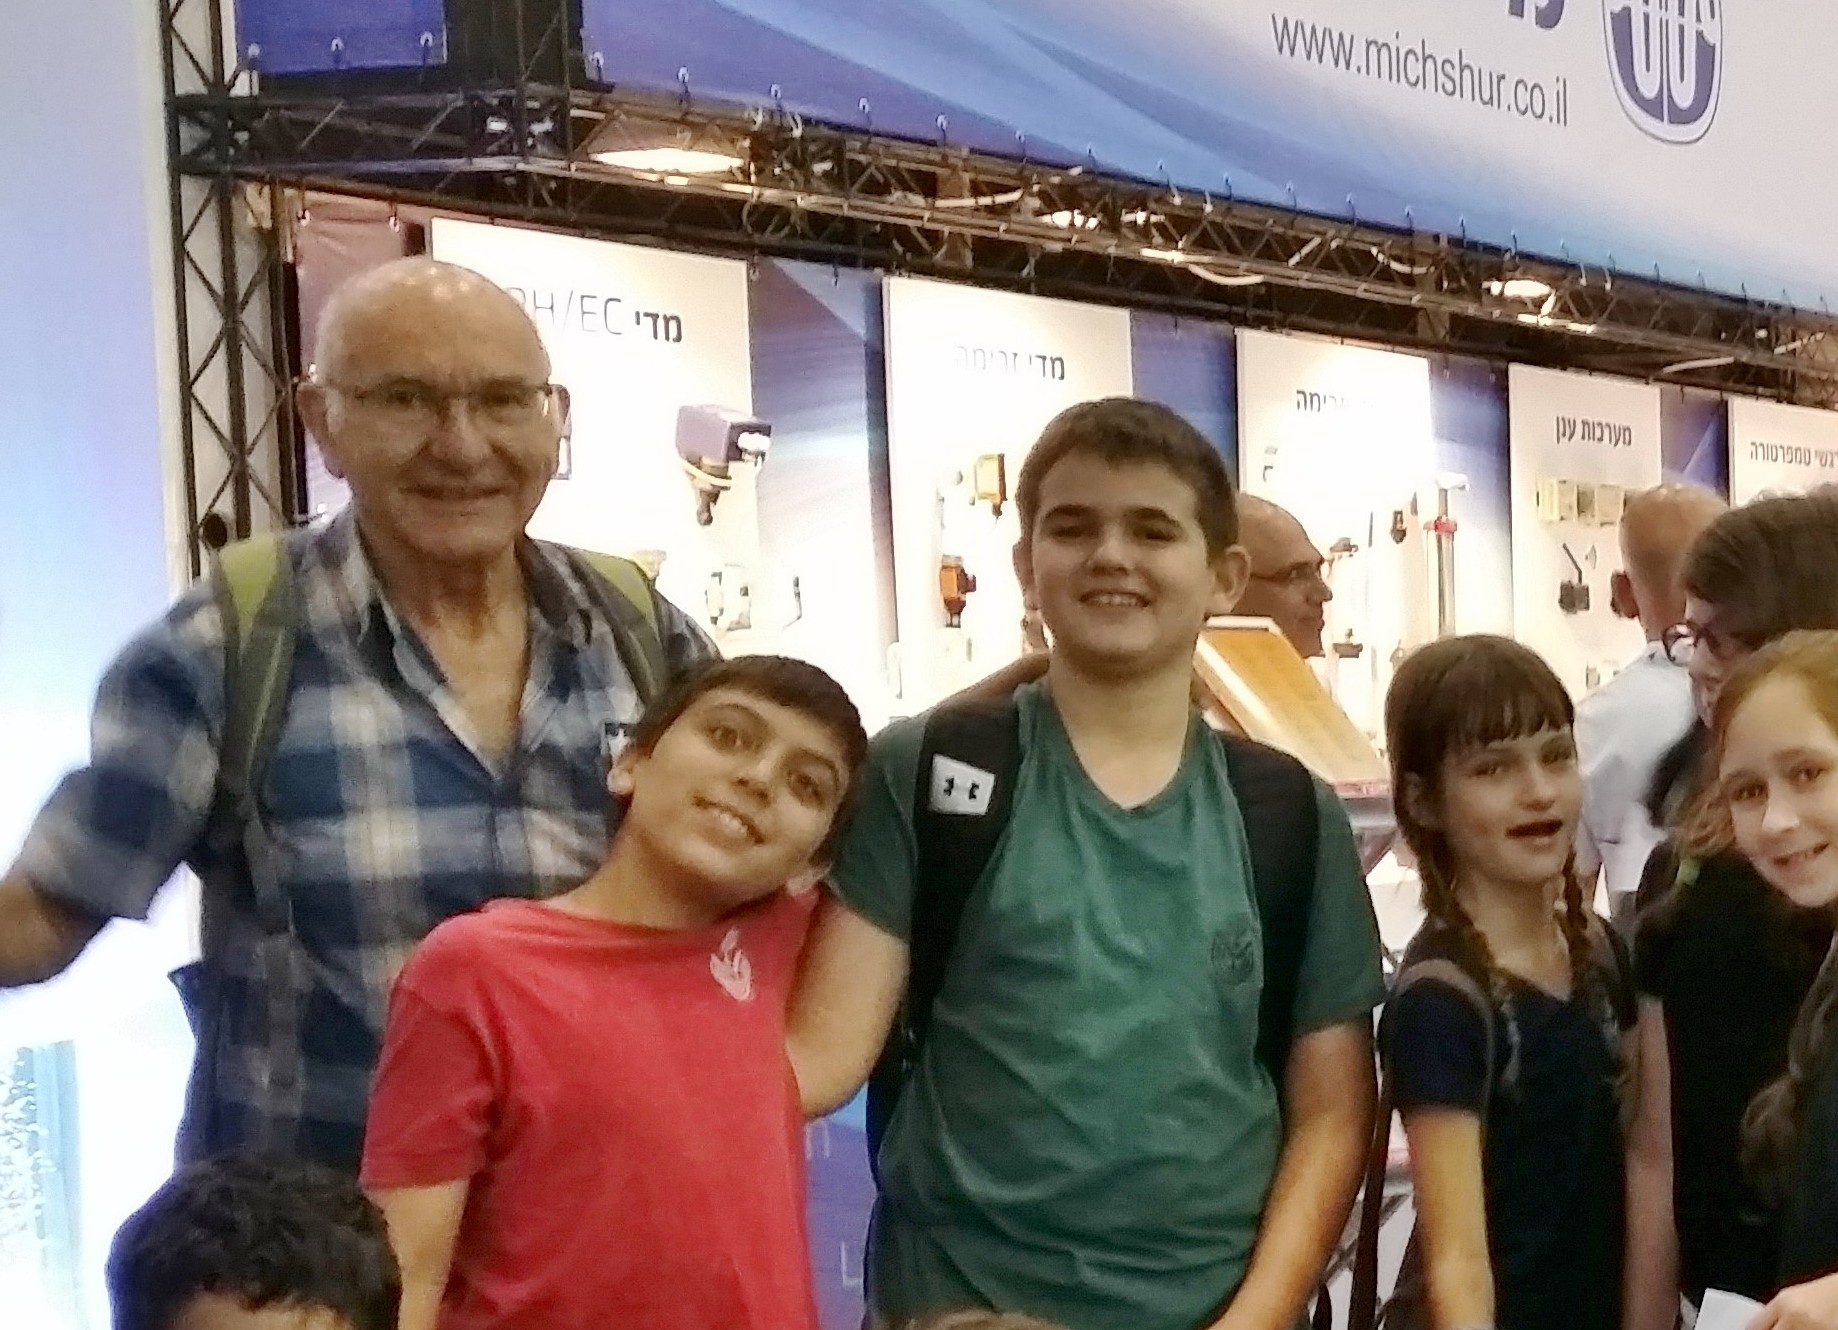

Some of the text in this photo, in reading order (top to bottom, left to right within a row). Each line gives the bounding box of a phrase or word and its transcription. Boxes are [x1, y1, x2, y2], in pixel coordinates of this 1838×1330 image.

[1271, 13, 1568, 127] www.michshur.co.il
[634, 310, 683, 343] מדי
[1580, 418, 1632, 448] מערכות
